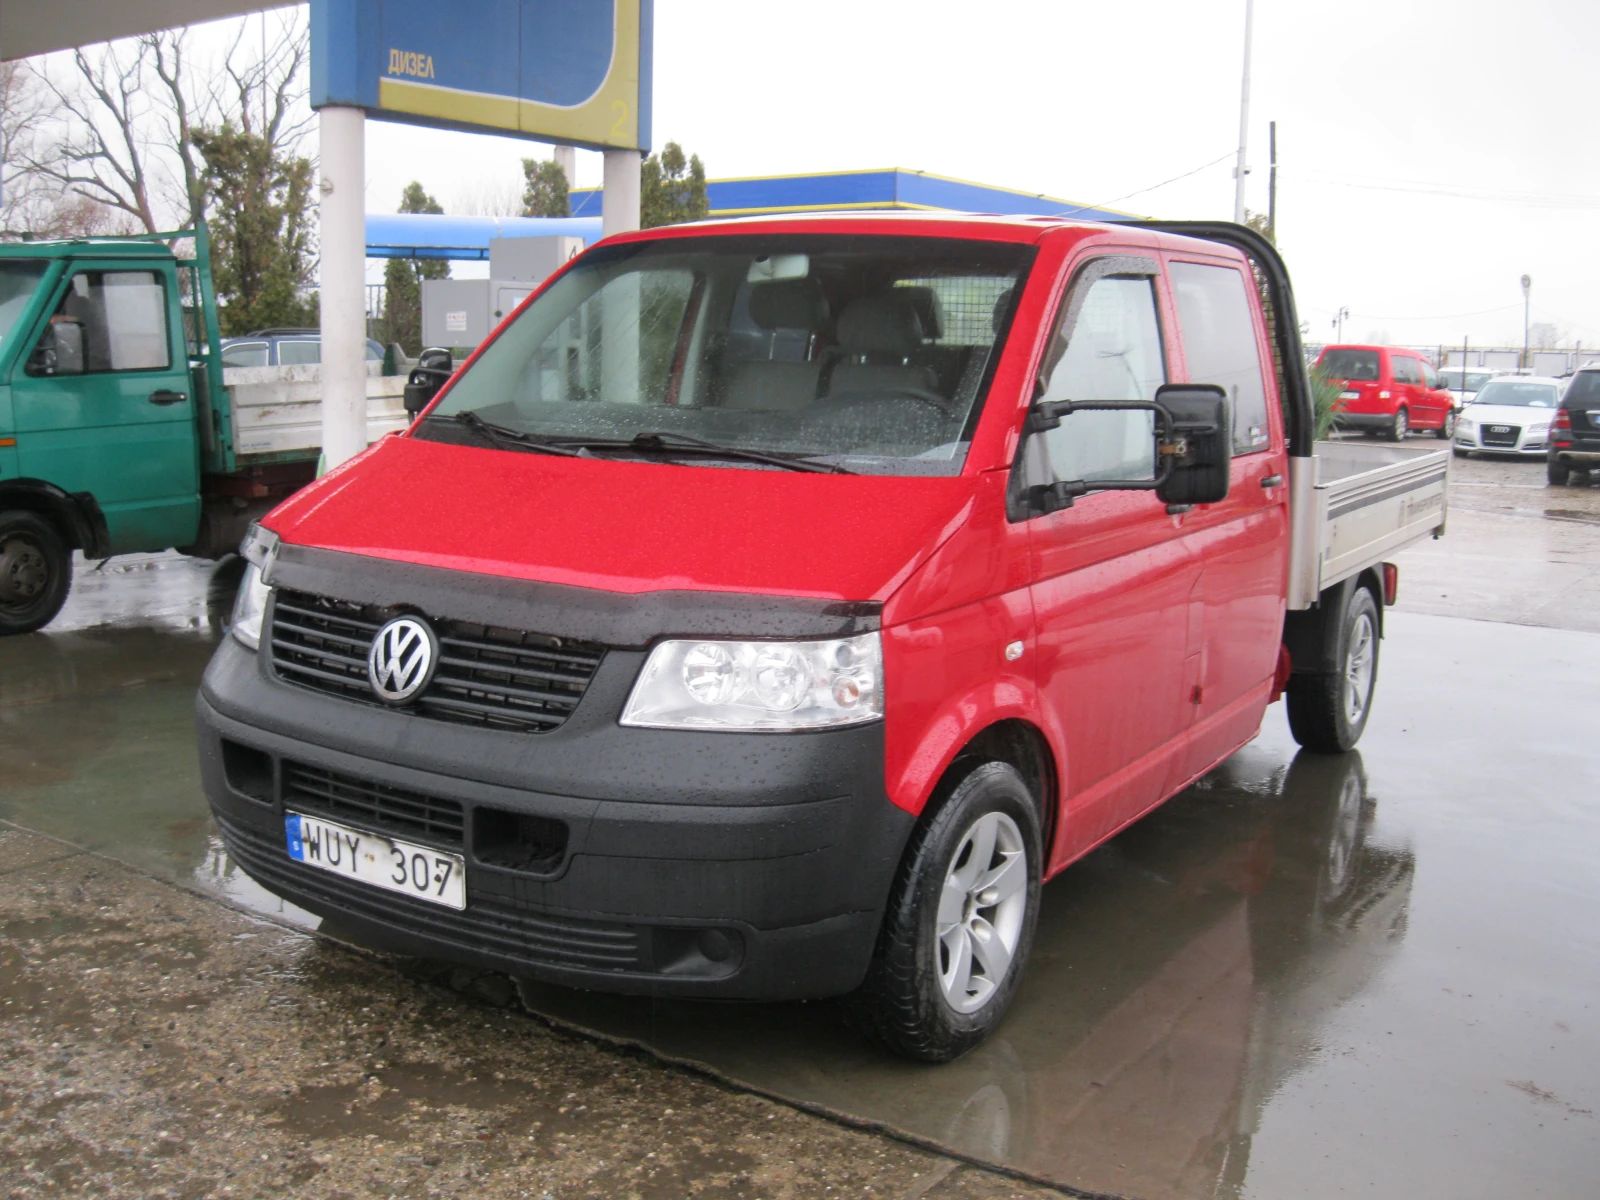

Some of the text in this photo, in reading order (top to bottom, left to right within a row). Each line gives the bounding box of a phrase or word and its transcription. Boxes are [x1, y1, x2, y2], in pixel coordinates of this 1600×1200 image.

[388, 48, 435, 79] ДИЗЕЛ
[611, 100, 628, 138] 2
[292, 840, 300, 851] S
[306, 822, 453, 897] WUY 307
